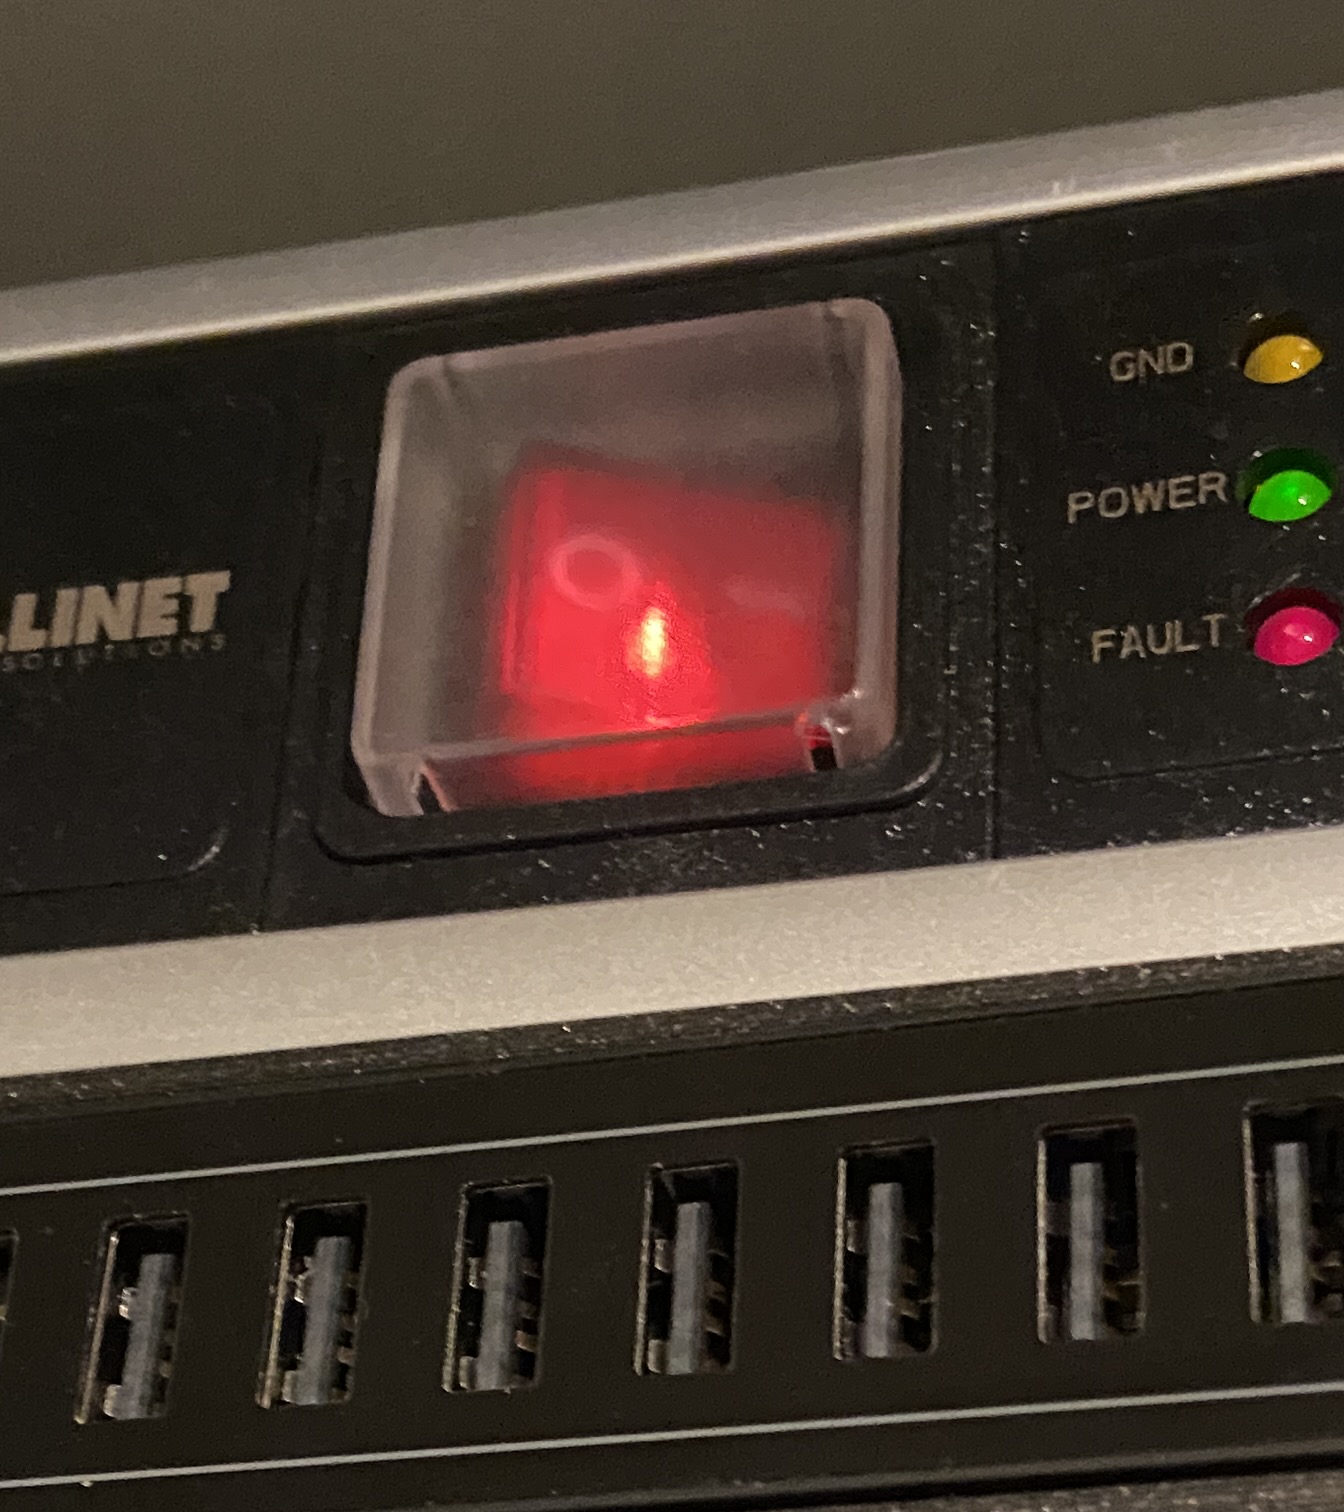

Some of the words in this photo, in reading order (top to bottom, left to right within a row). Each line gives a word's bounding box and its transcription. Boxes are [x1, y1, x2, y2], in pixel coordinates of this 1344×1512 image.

[1108, 341, 1195, 383] GND
[1065, 470, 1230, 524] POWER
[1089, 612, 1230, 664] FAULT
